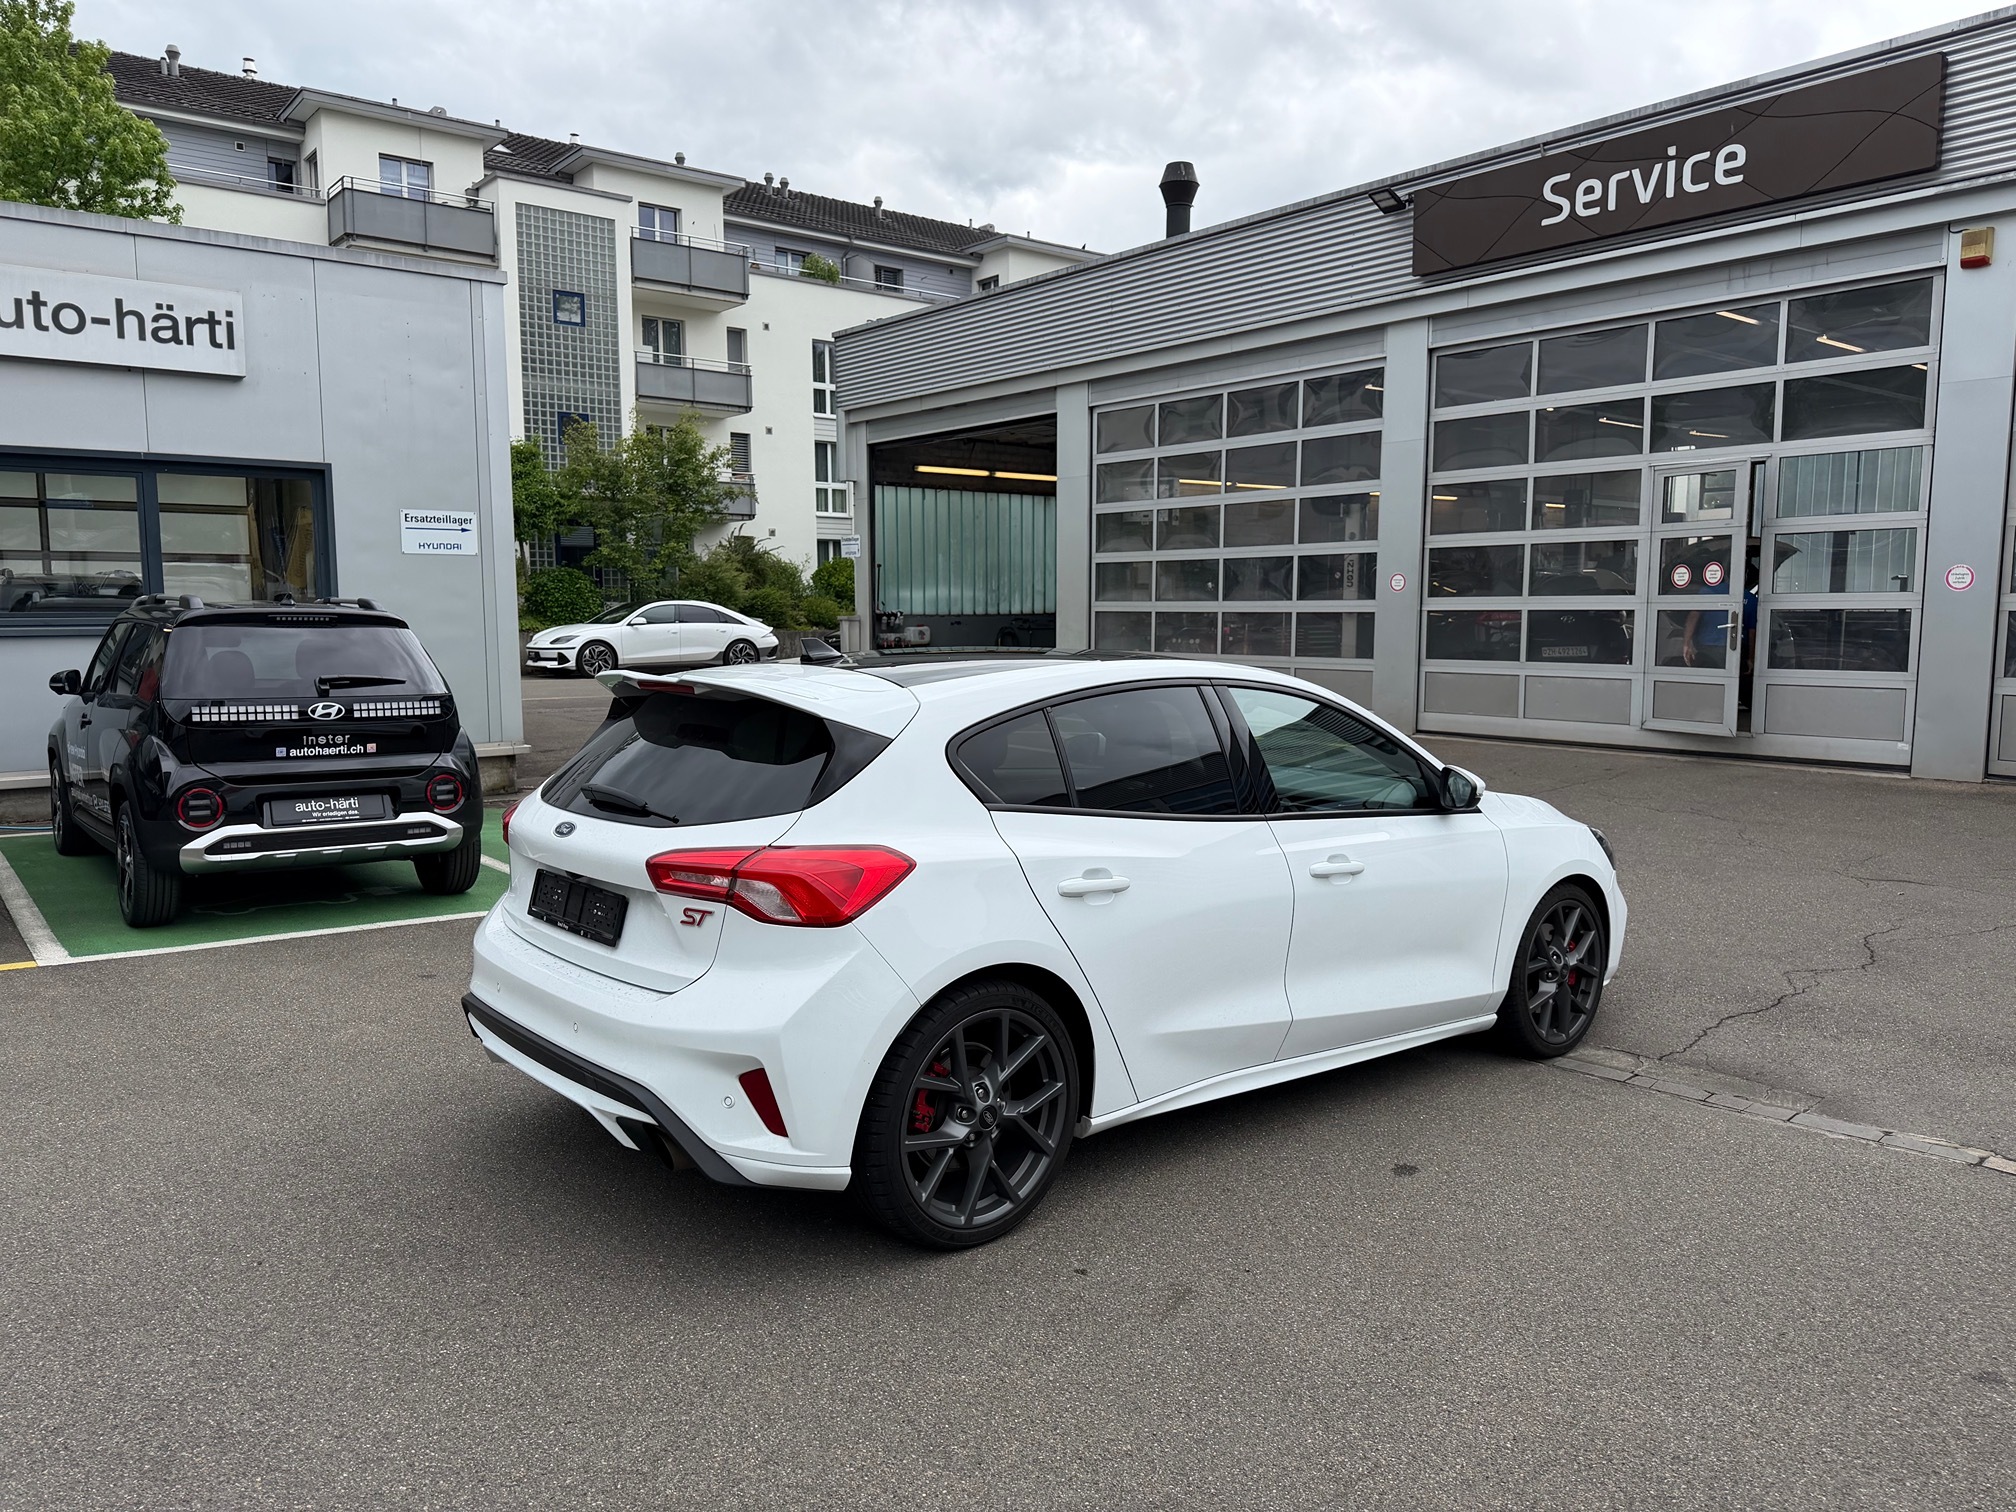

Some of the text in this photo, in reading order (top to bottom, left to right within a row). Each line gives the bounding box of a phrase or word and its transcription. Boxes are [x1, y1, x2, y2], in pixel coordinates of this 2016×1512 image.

[1540, 143, 1747, 227] Service
[404, 512, 473, 527] Ersatzteillager
[418, 542, 462, 551] HYUNDAI
[289, 744, 364, 757] autohaerti.ch
[295, 797, 359, 812] auto-härti
[680, 907, 715, 927] ST
